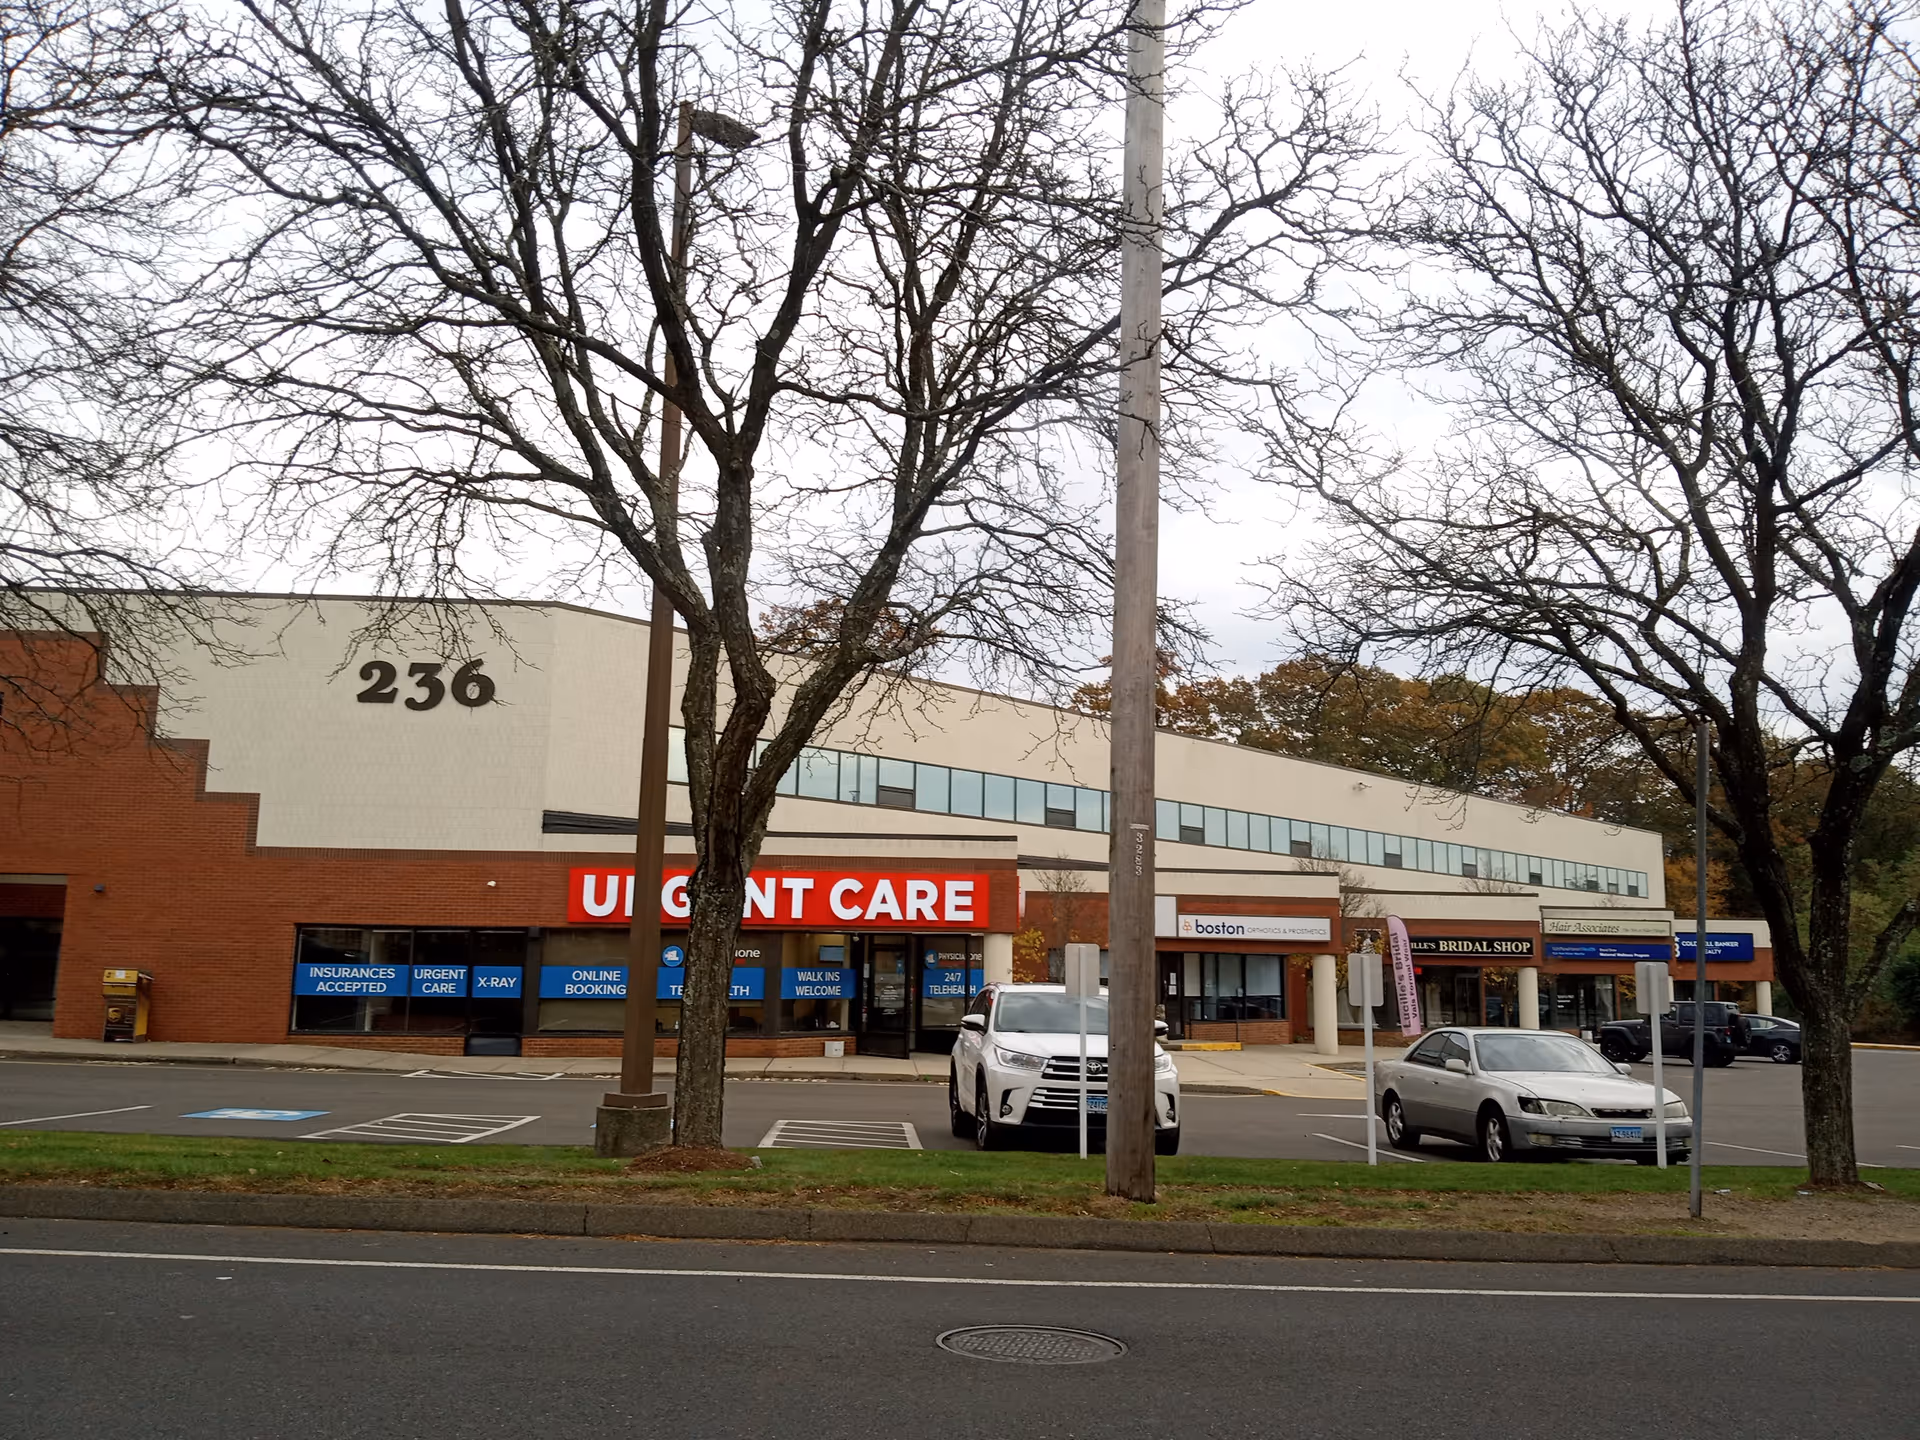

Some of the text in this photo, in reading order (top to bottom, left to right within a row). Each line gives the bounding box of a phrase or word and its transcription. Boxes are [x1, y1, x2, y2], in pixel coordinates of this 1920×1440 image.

[356, 658, 495, 711] 236
[583, 874, 974, 922] UGNT CARE
[1195, 919, 1245, 935] boston
[1548, 921, 1572, 932] Hair
[1572, 922, 1620, 933] Associates
[1402, 939, 1410, 962] Wear
[1439, 940, 1491, 952] BRIDAL
[1493, 941, 1531, 952] SHOP
[309, 966, 396, 980] INSURANCES
[414, 969, 466, 981] URGENT
[572, 970, 621, 982] ONLINE
[797, 971, 840, 982] WALK INS
[944, 972, 962, 982] 24/7
[477, 976, 517, 988] X-RAY
[1390, 932, 1412, 1029] Lucille's Bridal
[1406, 964, 1416, 996] Formal
[316, 981, 387, 993] ACCEPTED
[422, 982, 456, 994] CARE
[564, 984, 627, 996] BOOKING
[795, 985, 841, 996] WELCOME
[929, 985, 976, 994] TELEHEALH
